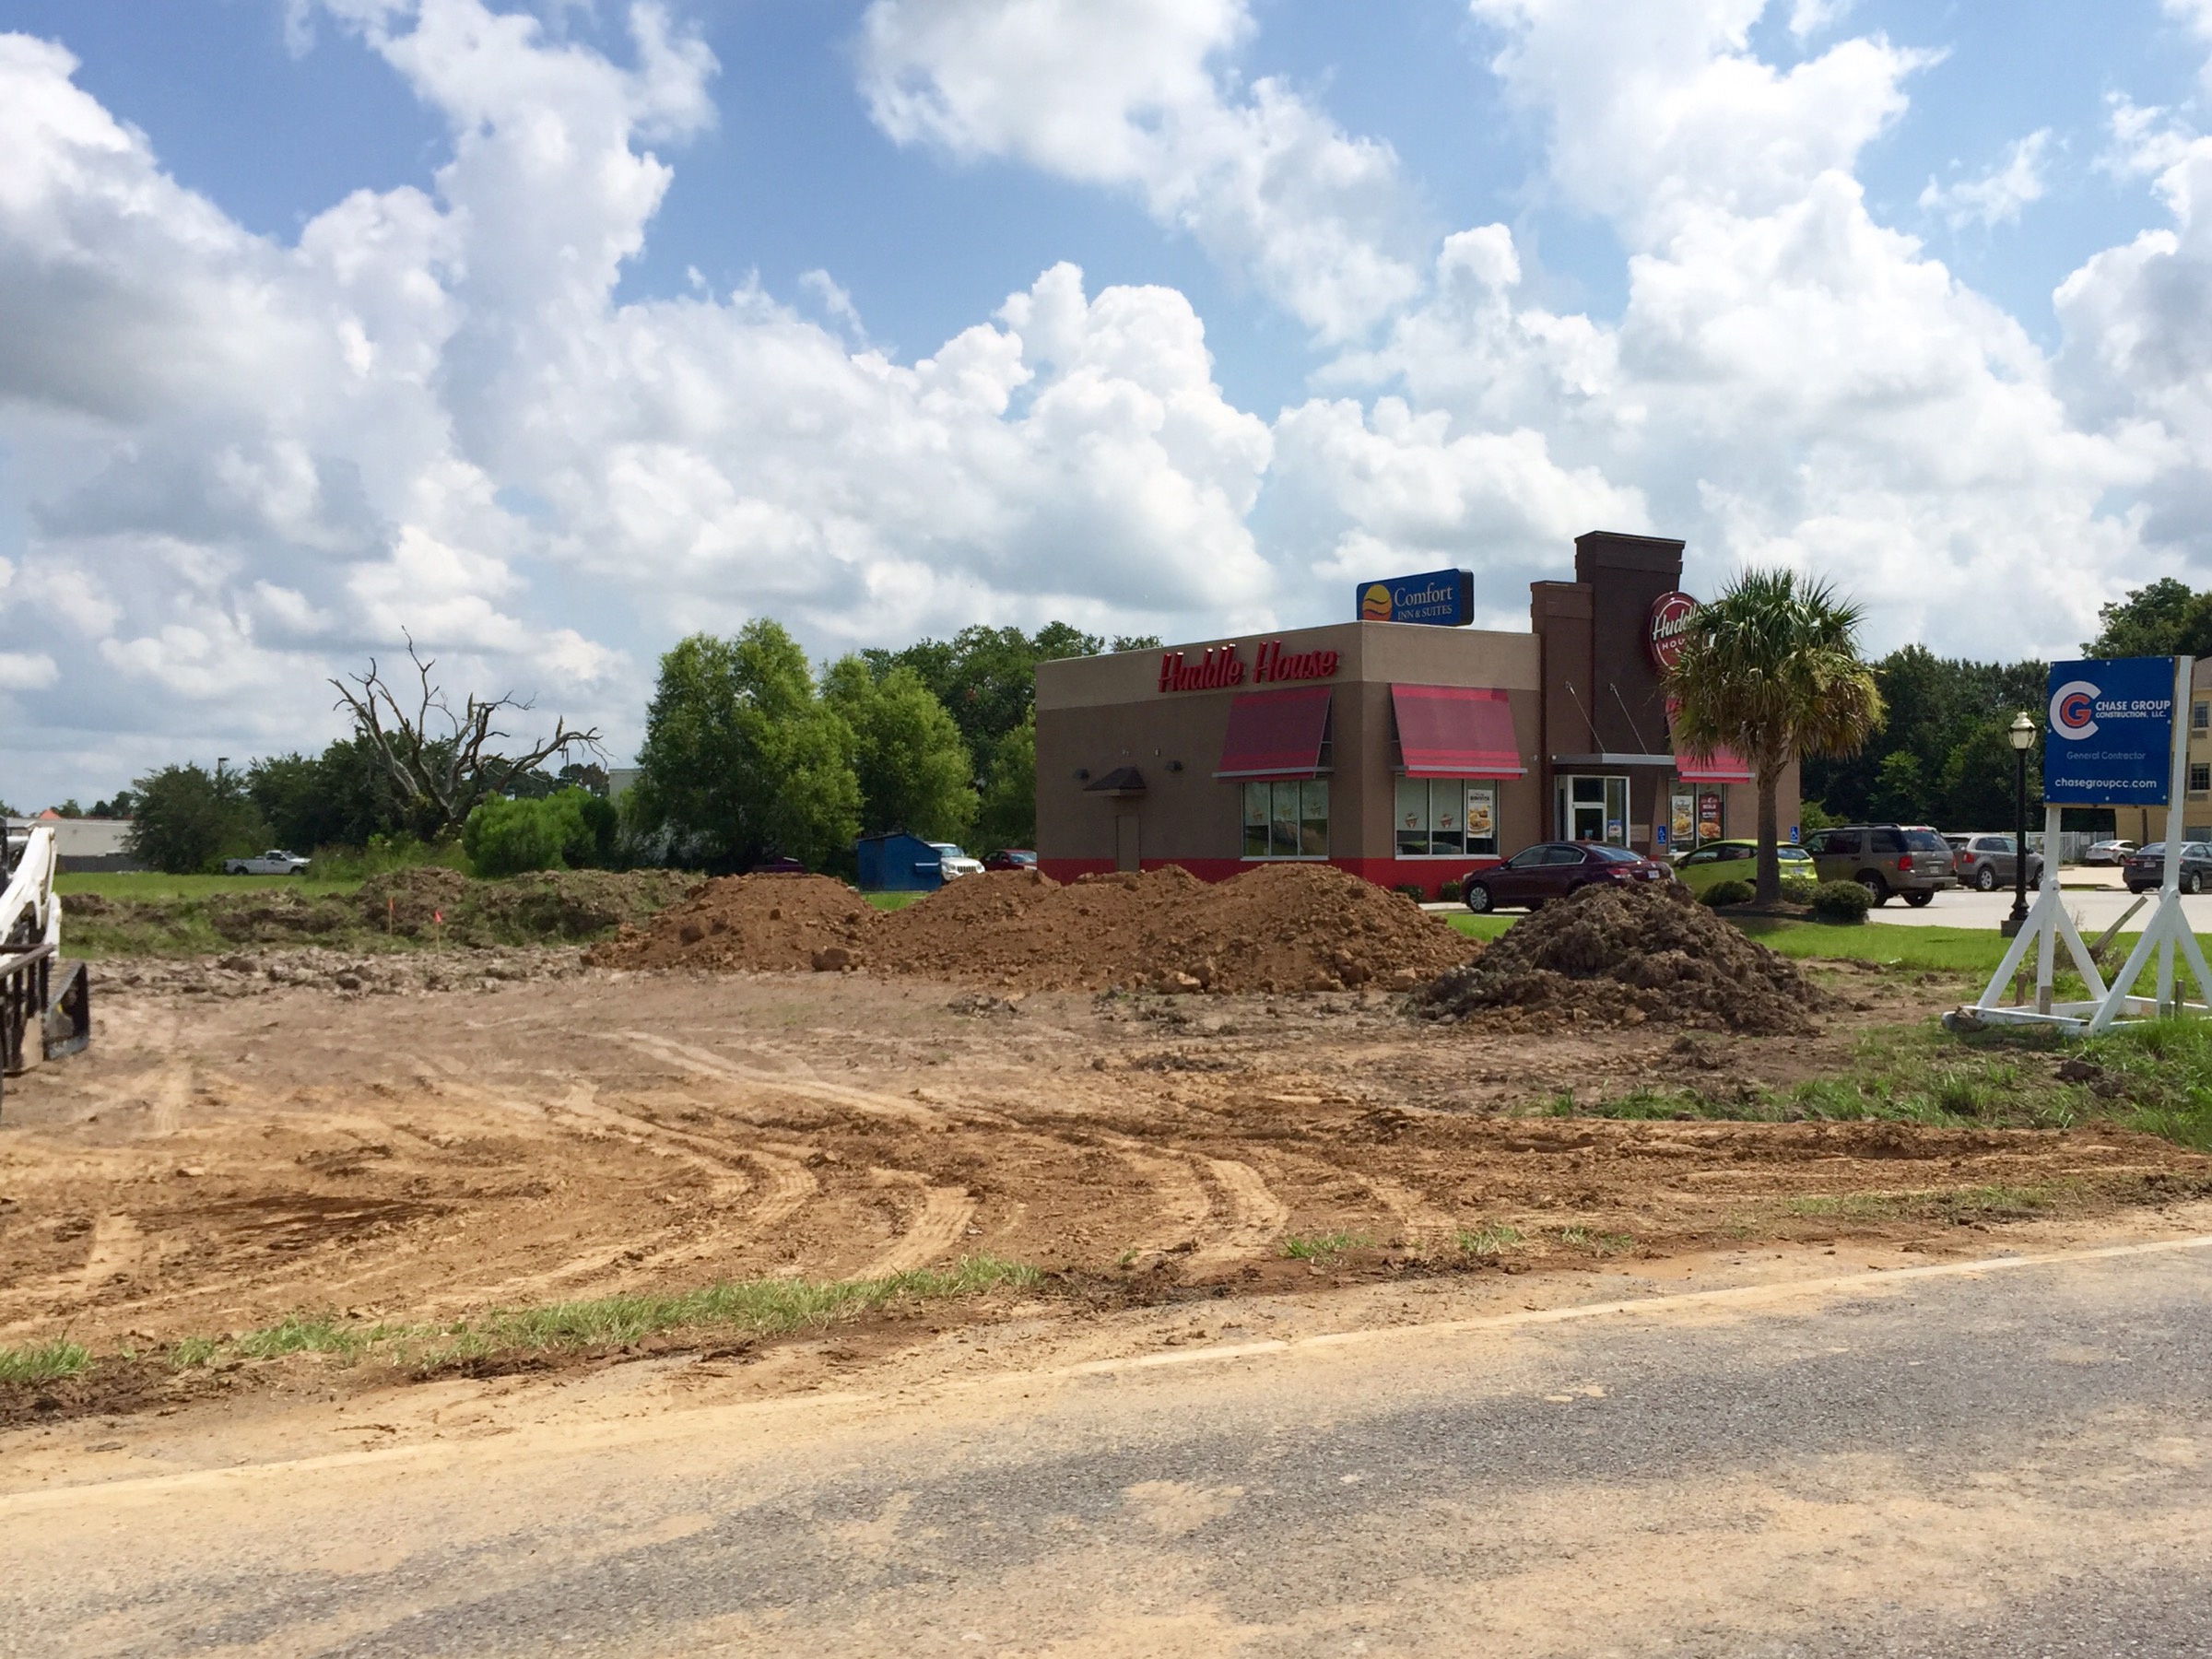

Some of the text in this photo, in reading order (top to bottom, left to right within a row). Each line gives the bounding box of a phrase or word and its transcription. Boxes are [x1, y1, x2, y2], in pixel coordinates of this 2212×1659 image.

[1394, 582, 1453, 606] Comfort
[1398, 610, 1414, 620] INN
[1421, 605, 1453, 618] SUITES
[1159, 640, 1338, 693] Huddle House
[2096, 700, 2171, 711] CHASE GROUP
[2066, 751, 2146, 759] General Contractor
[2054, 778, 2157, 789] chasegroupcc.com
